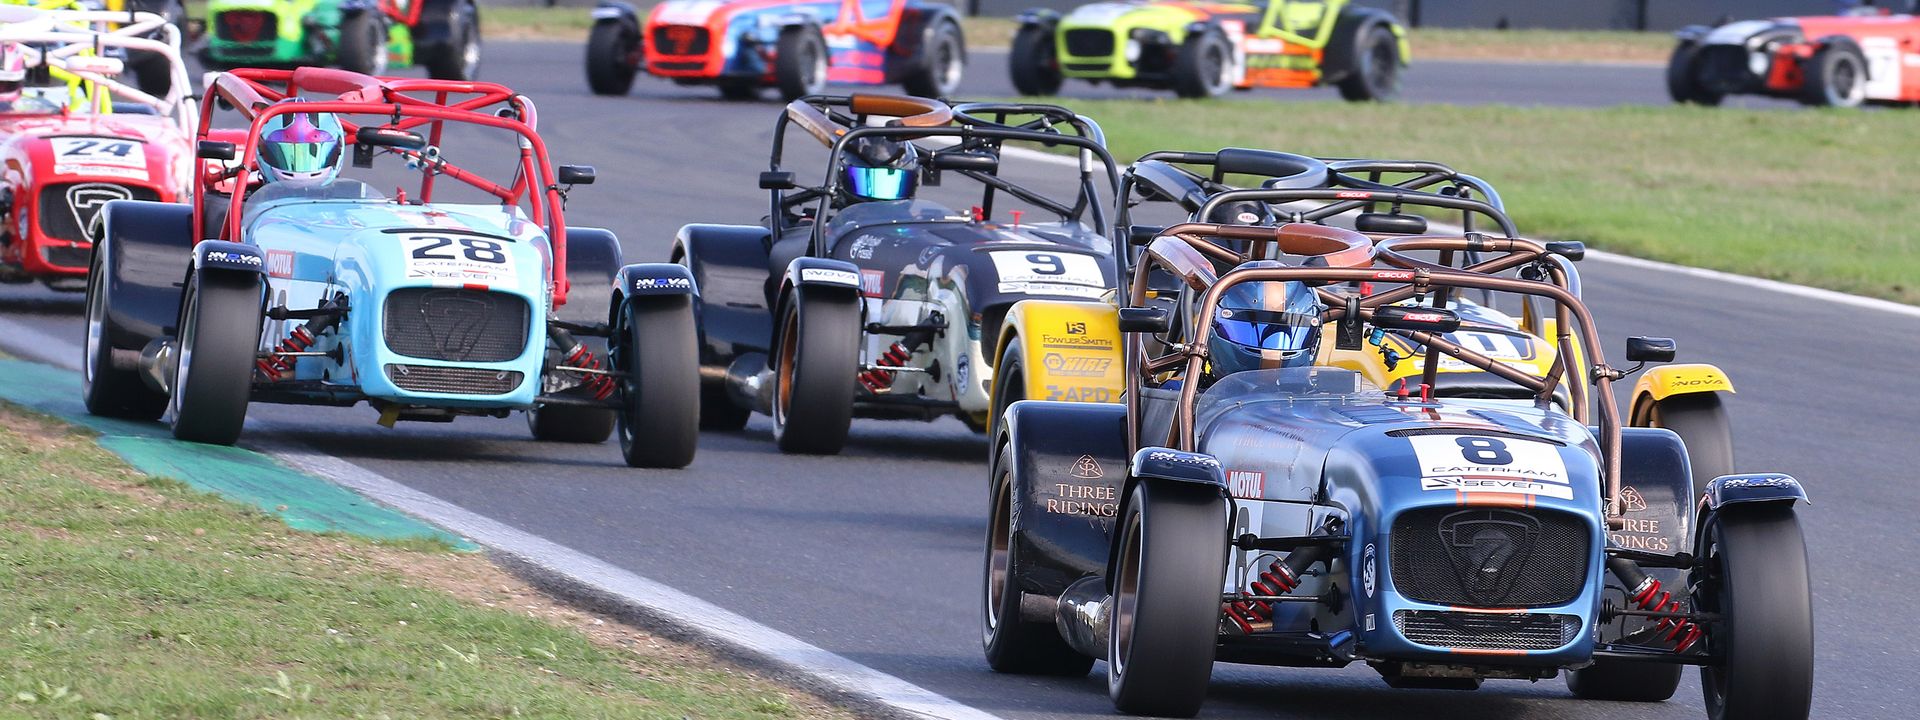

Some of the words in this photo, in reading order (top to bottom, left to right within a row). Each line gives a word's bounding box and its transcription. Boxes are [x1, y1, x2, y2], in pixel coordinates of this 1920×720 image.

[63, 141, 133, 156] 24
[409, 236, 506, 264] 28
[268, 253, 292, 274] MOTUL
[413, 261, 508, 271] CATERHAM
[1025, 254, 1066, 275] 9
[437, 271, 497, 280] SEVEN
[1003, 274, 1098, 284] CATERHAM
[1029, 283, 1089, 293] SEVEN
[1066, 356, 1113, 371] HIRE
[1065, 386, 1111, 402] APD
[1454, 436, 1514, 466] 8
[1431, 466, 1558, 478] CATERHAM
[1055, 483, 1115, 500] THREE
[1228, 471, 1263, 499] MOTUL
[1463, 480, 1544, 490] SEVEN
[1622, 518, 1659, 533] REE
[1612, 534, 1669, 551] DINGS
